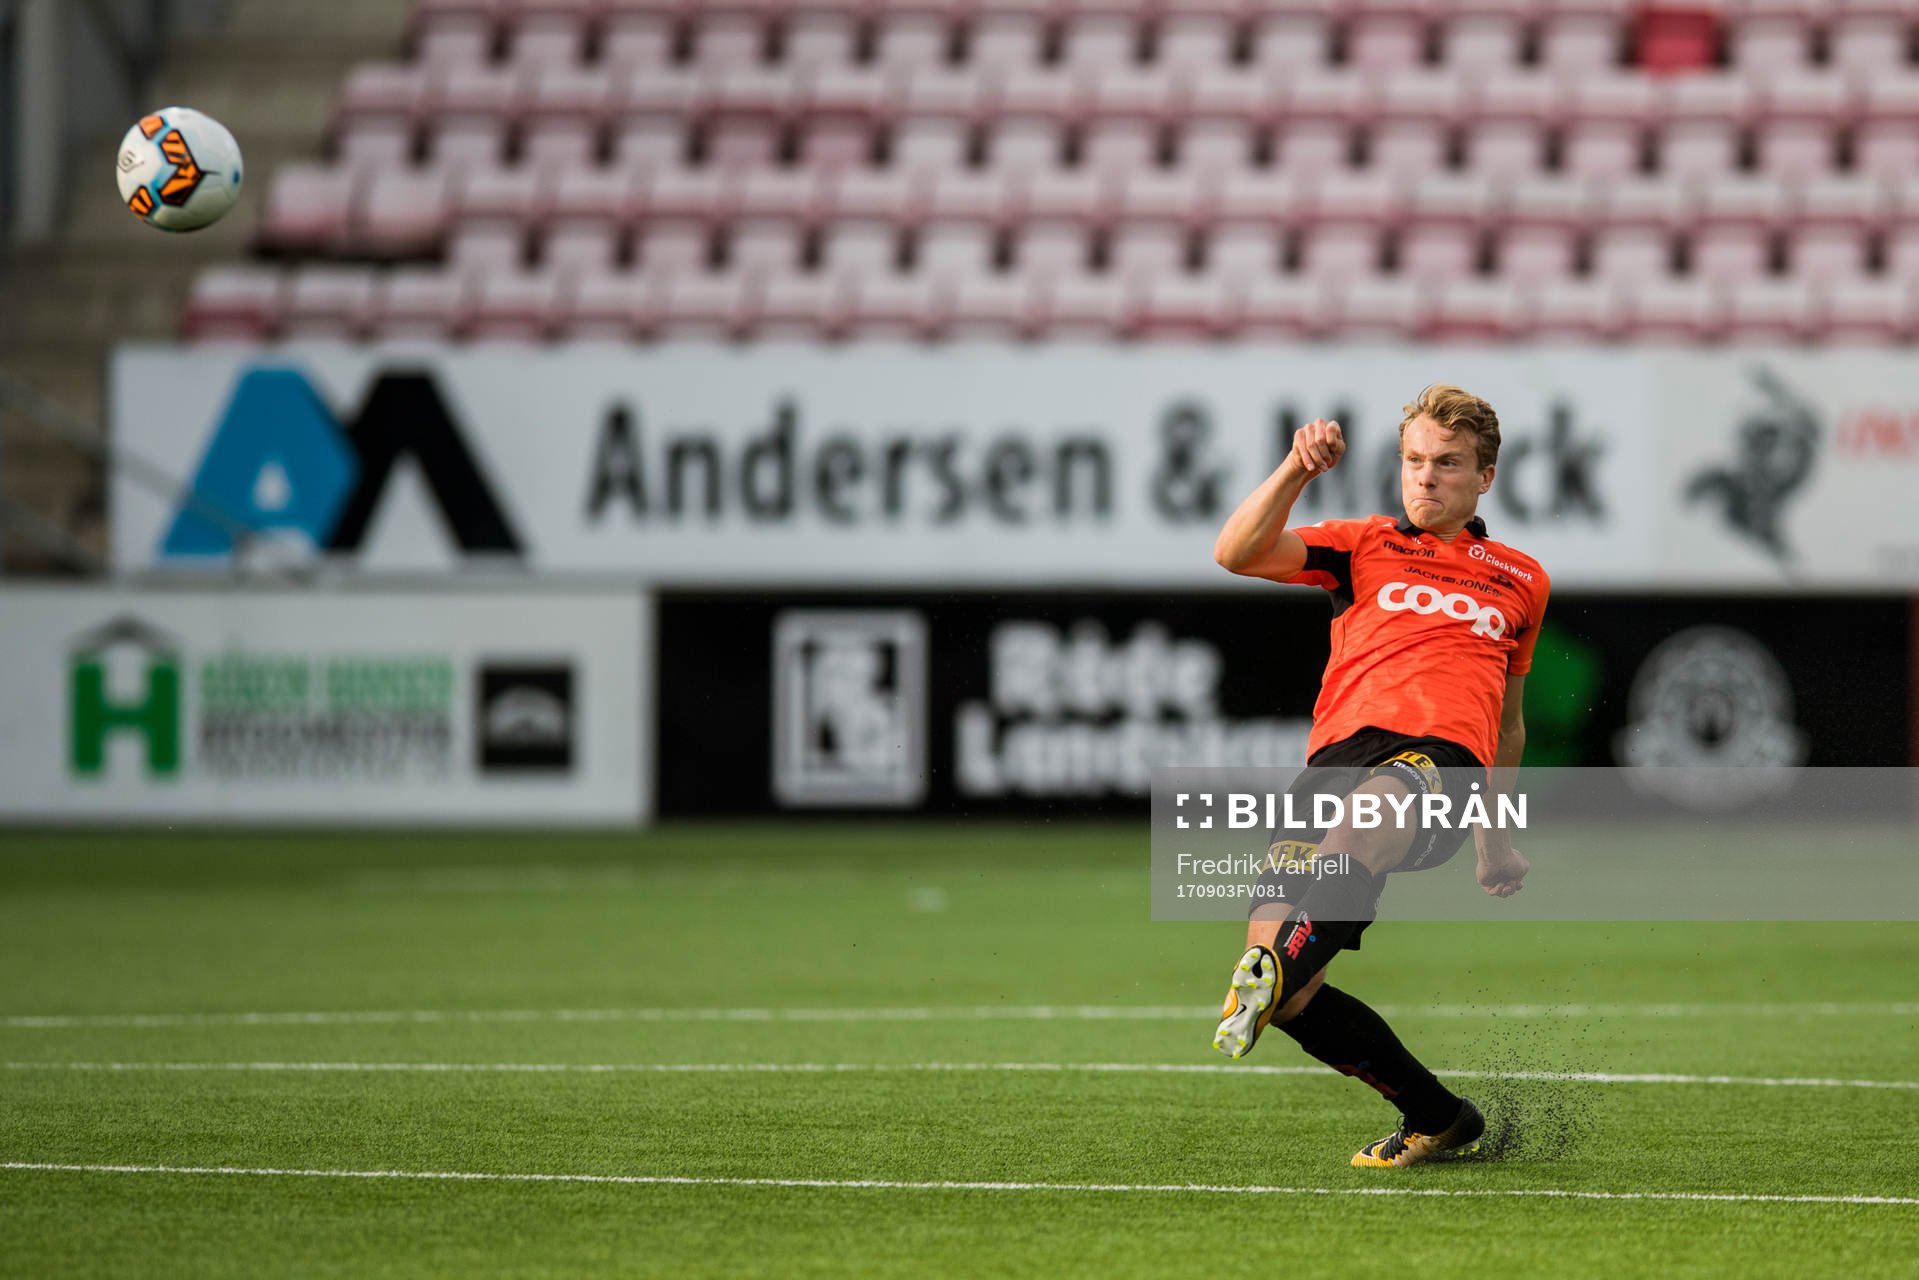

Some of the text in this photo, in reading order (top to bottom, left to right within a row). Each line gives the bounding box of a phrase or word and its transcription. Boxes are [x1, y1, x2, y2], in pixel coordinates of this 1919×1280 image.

[588, 401, 1111, 524] Andersen
[1152, 401, 1226, 522] &
[1383, 539, 1436, 559] macron
[1404, 566, 1440, 582] JACK
[1485, 553, 1533, 582] ClockWork
